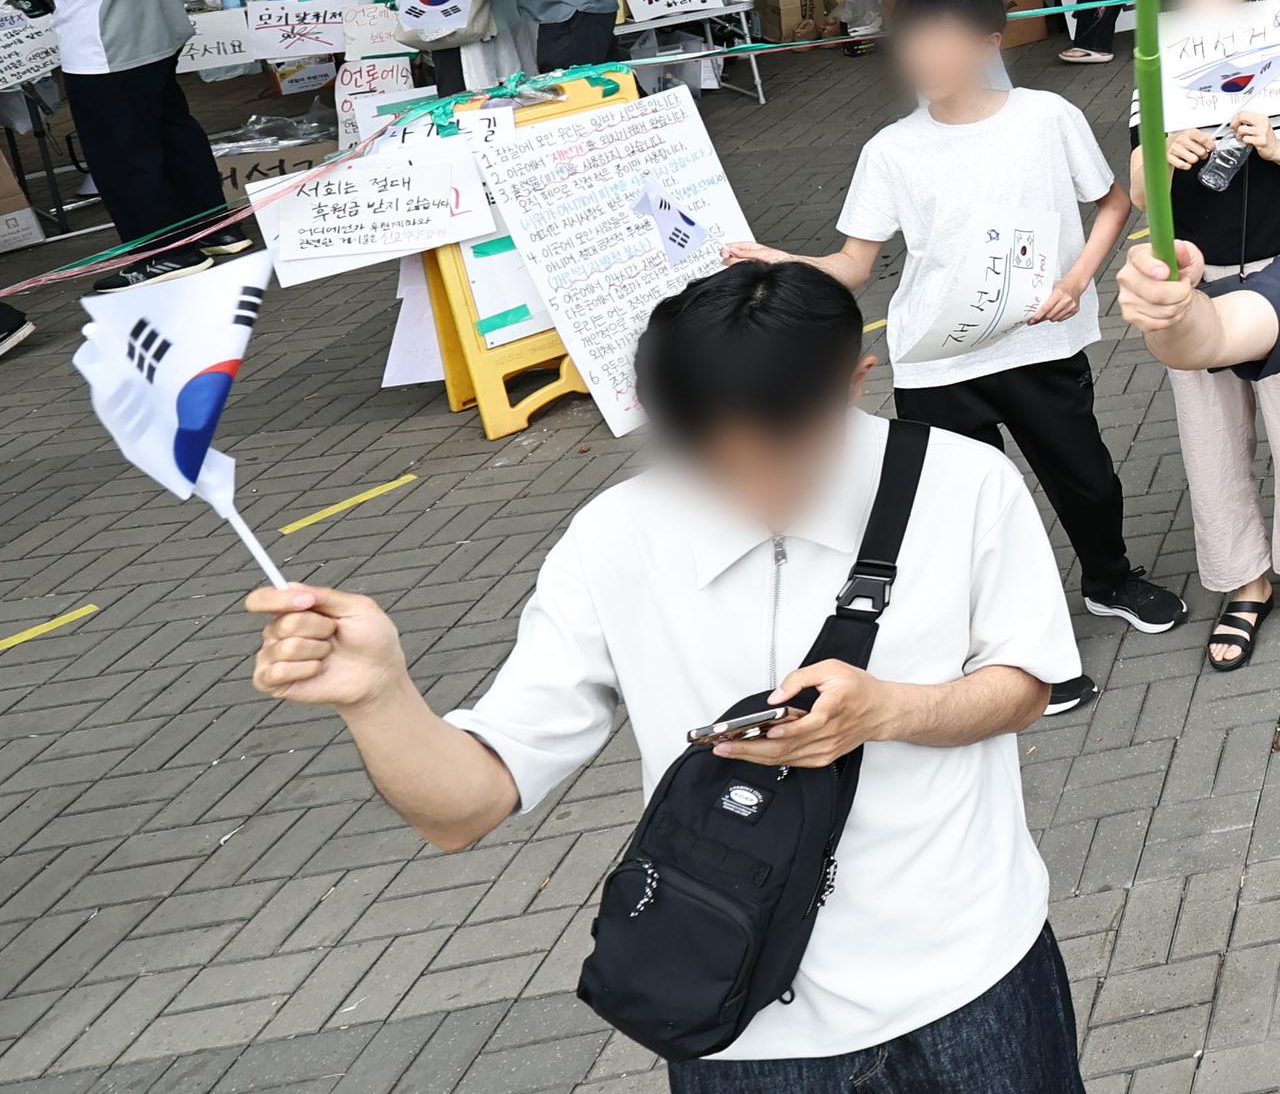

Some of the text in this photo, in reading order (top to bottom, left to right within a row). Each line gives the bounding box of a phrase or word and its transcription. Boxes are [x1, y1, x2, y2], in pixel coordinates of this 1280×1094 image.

[1168, 27, 1266, 58] 재선거
[340, 64, 400, 92] 언론에
[480, 116, 497, 143] 길
[370, 176, 411, 194] 절대
[312, 200, 361, 222] 후원금
[367, 197, 400, 215] 받지
[942, 255, 1004, 347] 재선거
